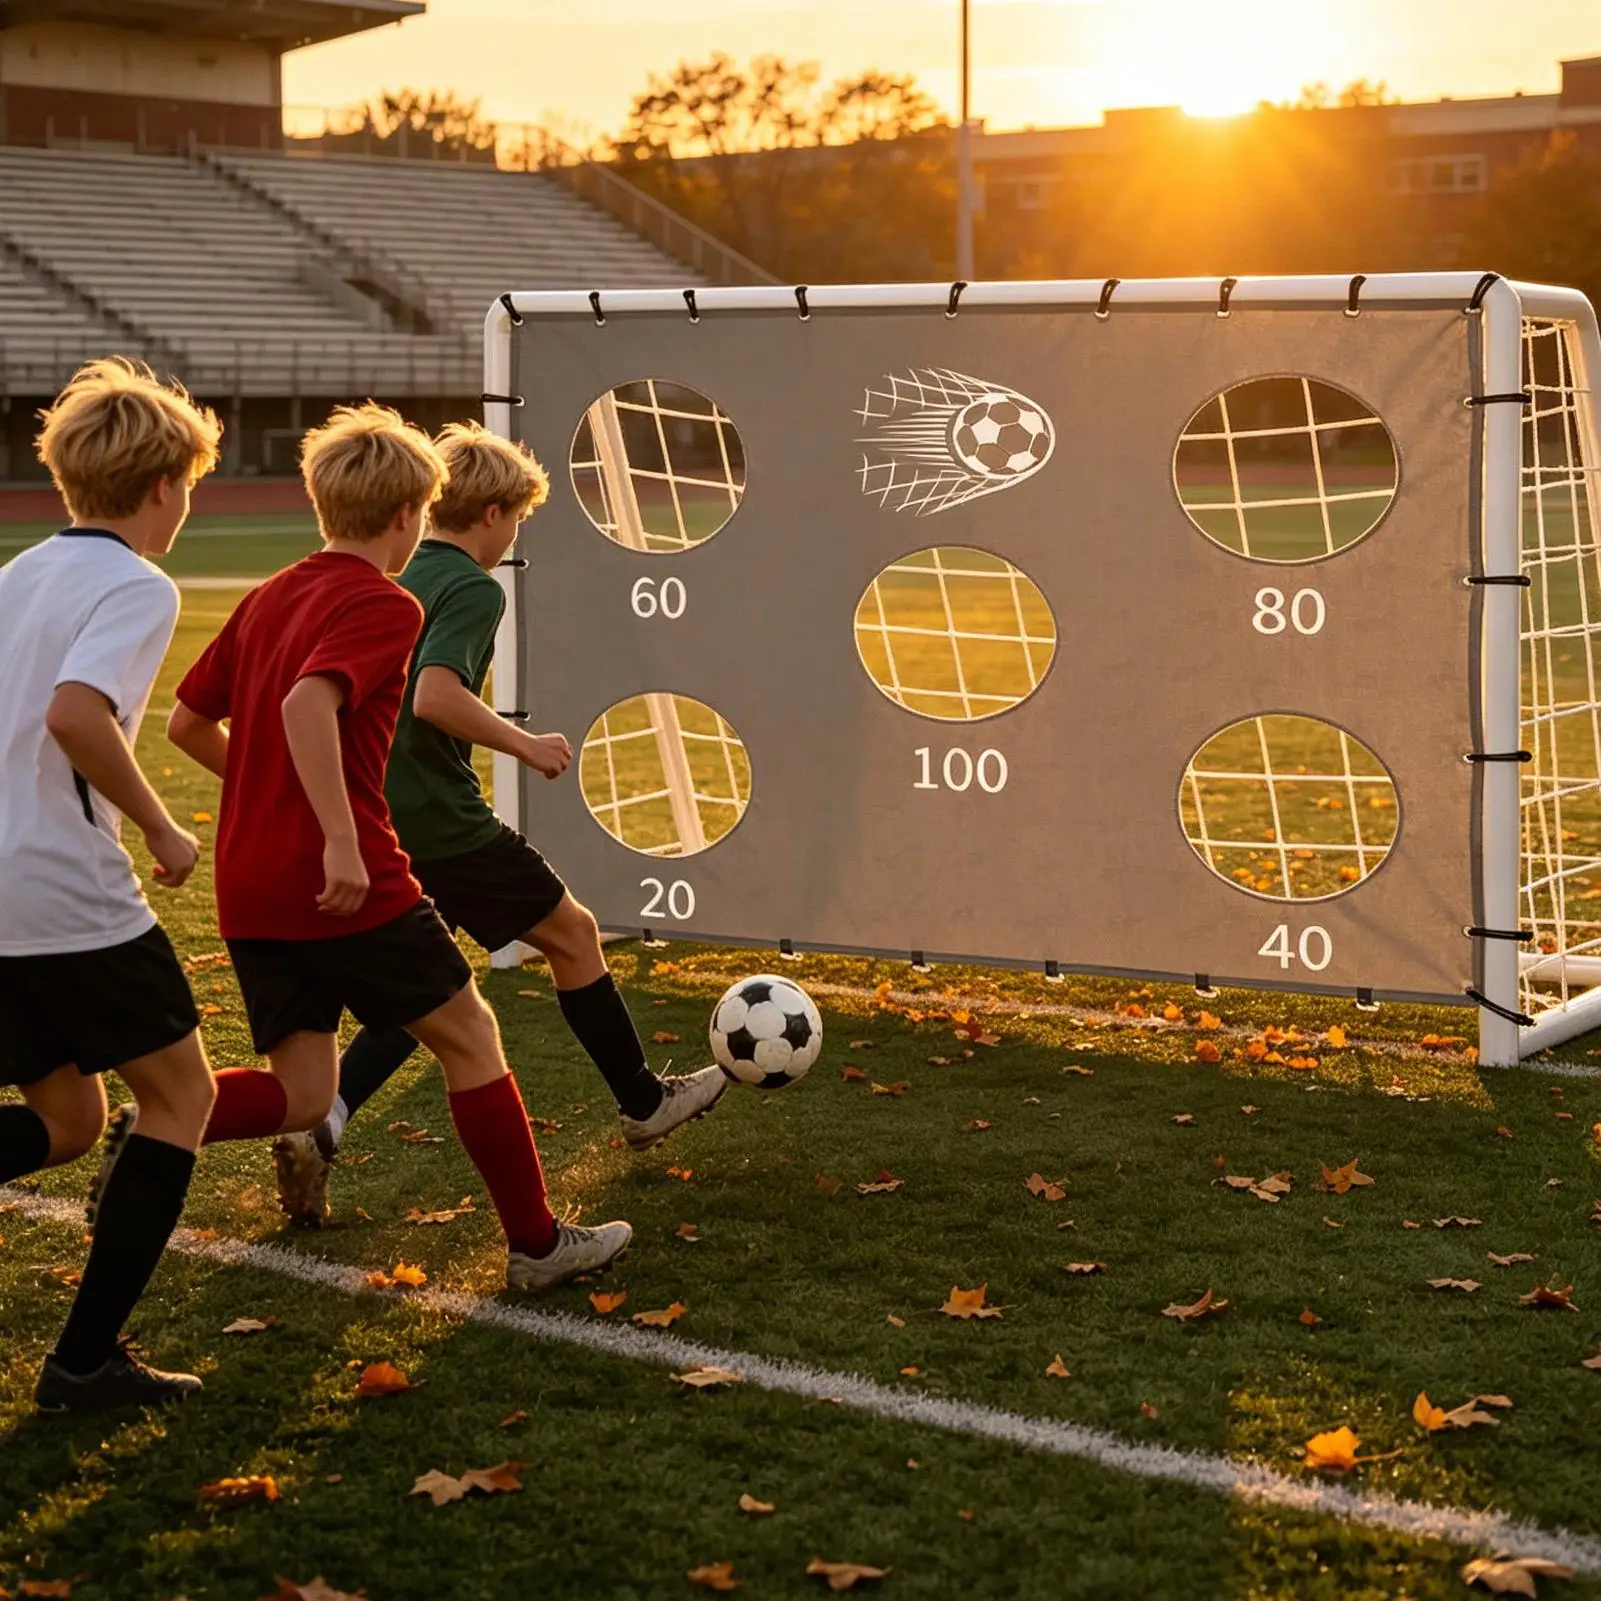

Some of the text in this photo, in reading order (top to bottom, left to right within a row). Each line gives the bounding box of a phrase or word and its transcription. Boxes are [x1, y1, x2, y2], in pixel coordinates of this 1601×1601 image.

[631, 577, 687, 619] 60
[1252, 587, 1326, 635] 80
[913, 747, 1008, 793] 100
[640, 877, 695, 920] 20
[1258, 924, 1333, 971] 40
